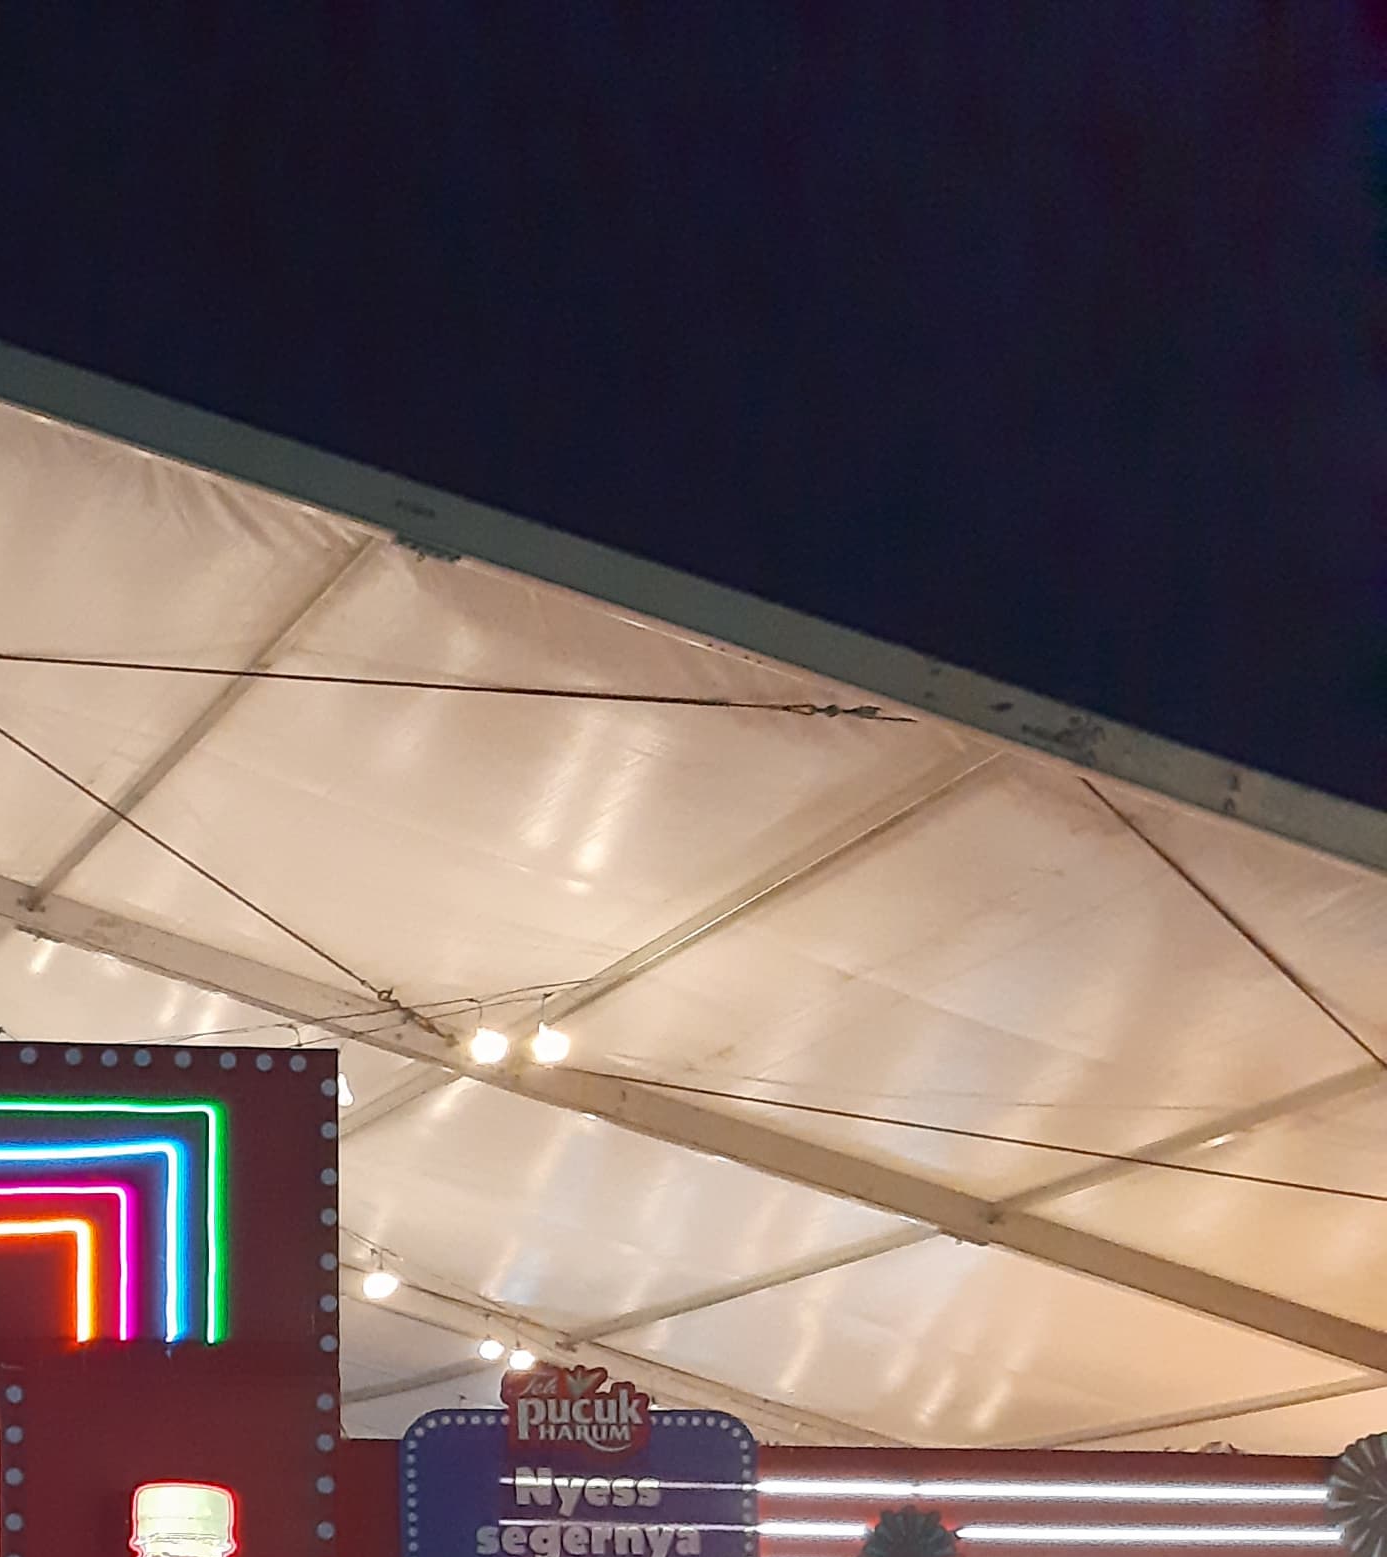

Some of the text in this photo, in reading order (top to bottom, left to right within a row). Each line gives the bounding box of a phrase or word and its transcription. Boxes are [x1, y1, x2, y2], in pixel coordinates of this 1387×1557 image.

[517, 1388, 643, 1440] pucuk
[539, 1424, 631, 1445] HARUM
[514, 1467, 661, 1517] Nyess
